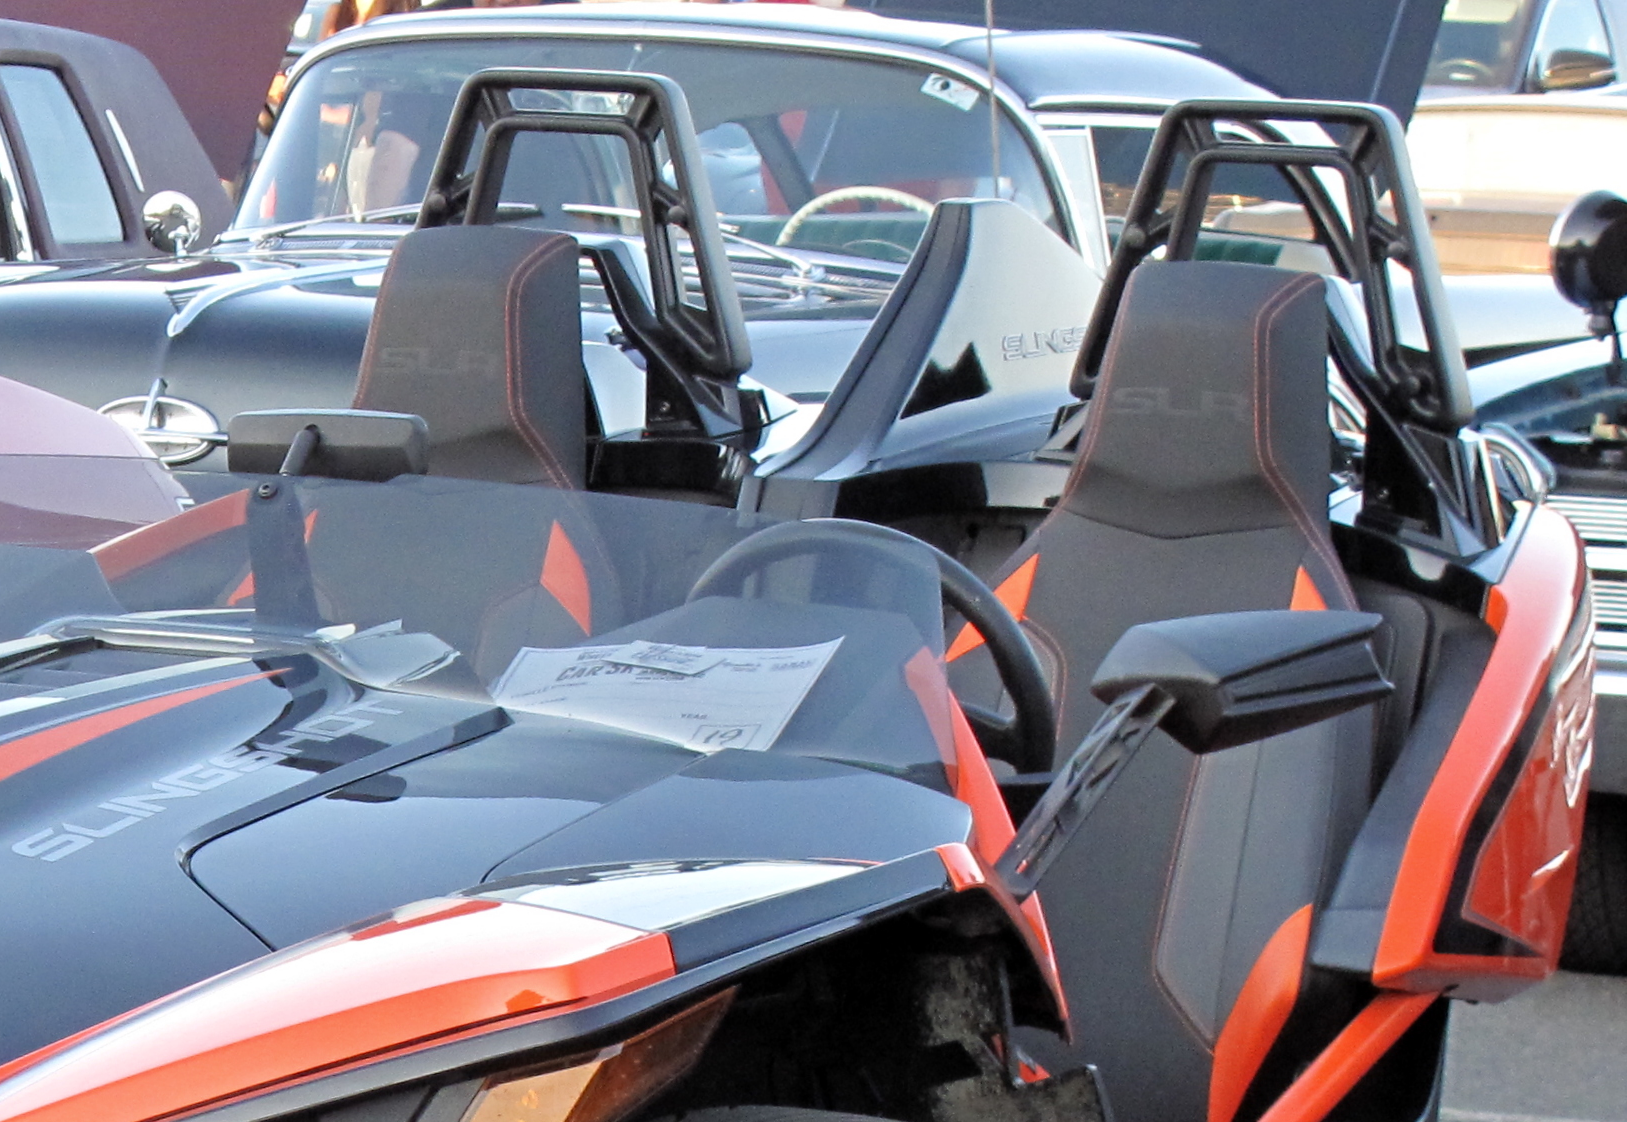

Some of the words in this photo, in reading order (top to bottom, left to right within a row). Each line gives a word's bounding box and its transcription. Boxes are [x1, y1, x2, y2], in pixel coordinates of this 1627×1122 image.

[1001, 325, 1088, 361] SLINGS
[555, 665, 604, 682] CAR
[11, 701, 404, 863] SLINGSHOT
